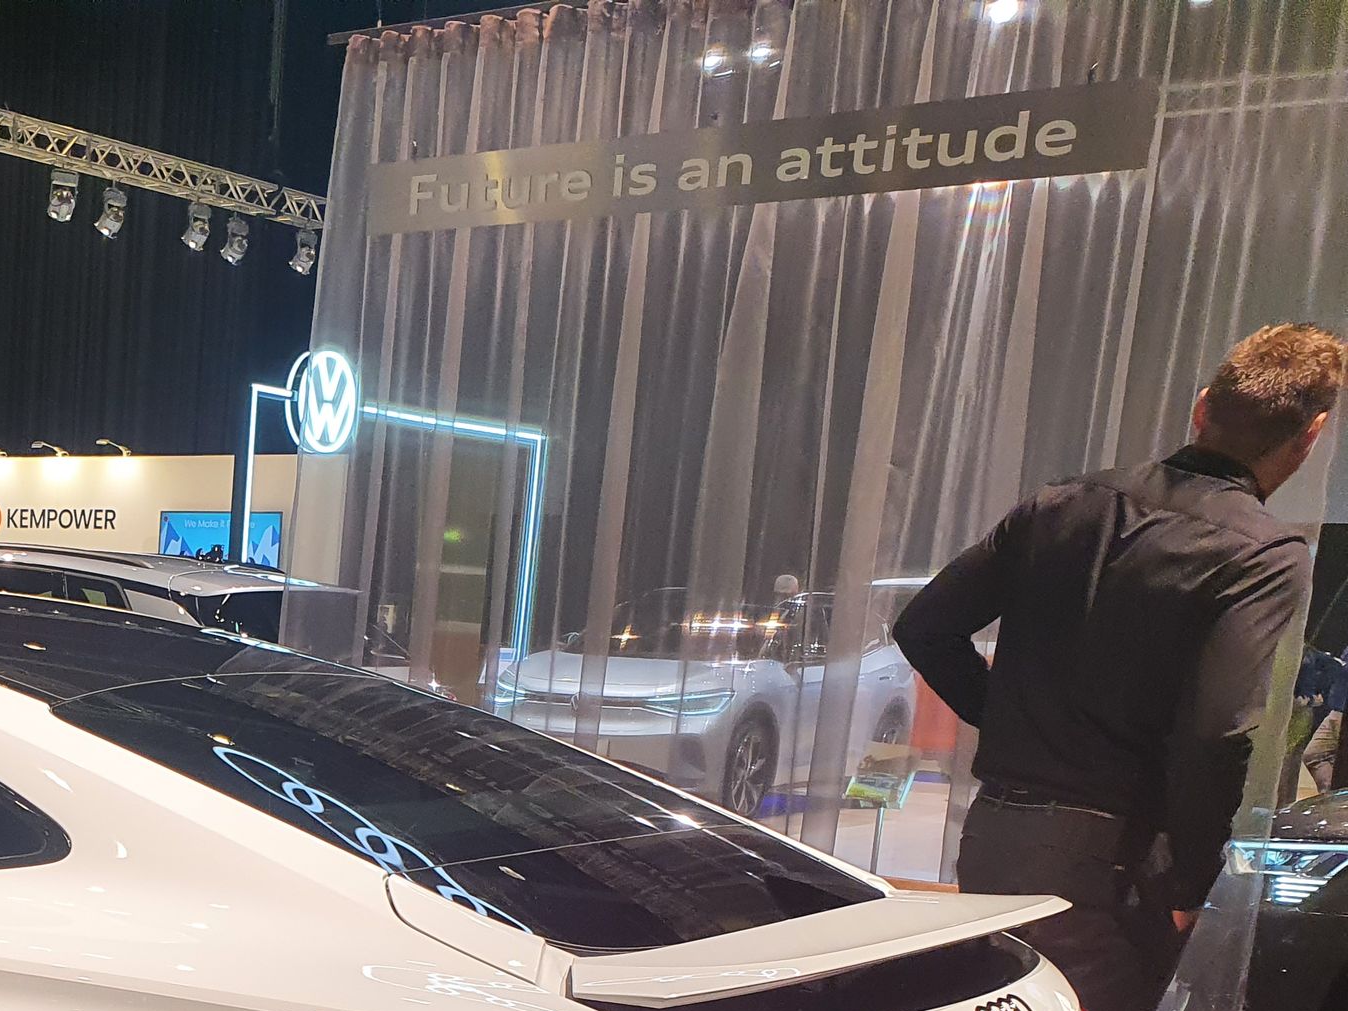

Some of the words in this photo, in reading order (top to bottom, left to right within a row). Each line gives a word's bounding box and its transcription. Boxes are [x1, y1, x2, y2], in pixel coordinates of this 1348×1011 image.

[409, 168, 592, 216] Future
[612, 153, 657, 198] is
[677, 152, 753, 192] an
[775, 110, 1078, 183] attitude
[7, 508, 117, 530] KEMPOWER
